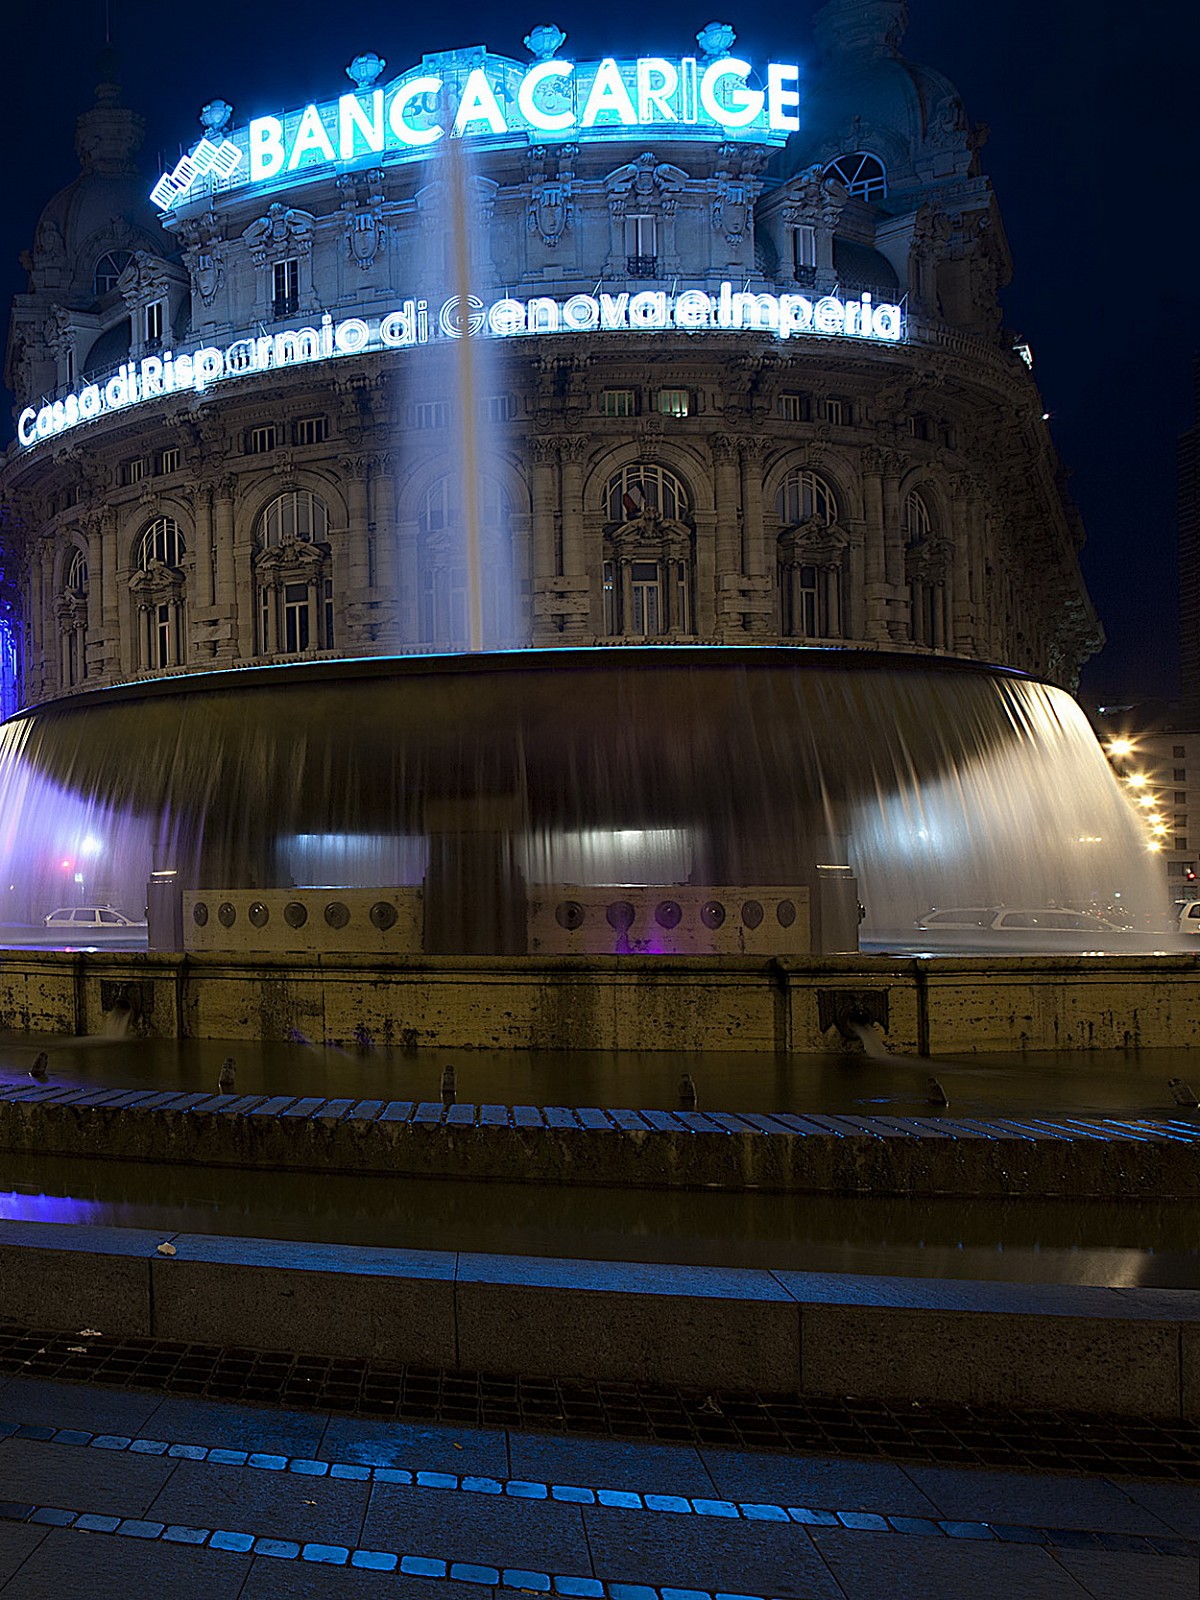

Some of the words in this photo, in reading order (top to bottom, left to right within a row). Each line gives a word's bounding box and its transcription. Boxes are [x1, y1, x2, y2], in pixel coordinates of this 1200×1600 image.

[249, 69, 508, 181] BANCA
[517, 57, 799, 131] CARIGE
[17, 384, 100, 446] Cassa
[107, 360, 136, 408] di
[141, 314, 370, 391] Risparmio
[380, 300, 428, 346] di
[439, 290, 665, 338] Genova
[675, 291, 713, 328] e
[720, 281, 903, 340] Imperia
